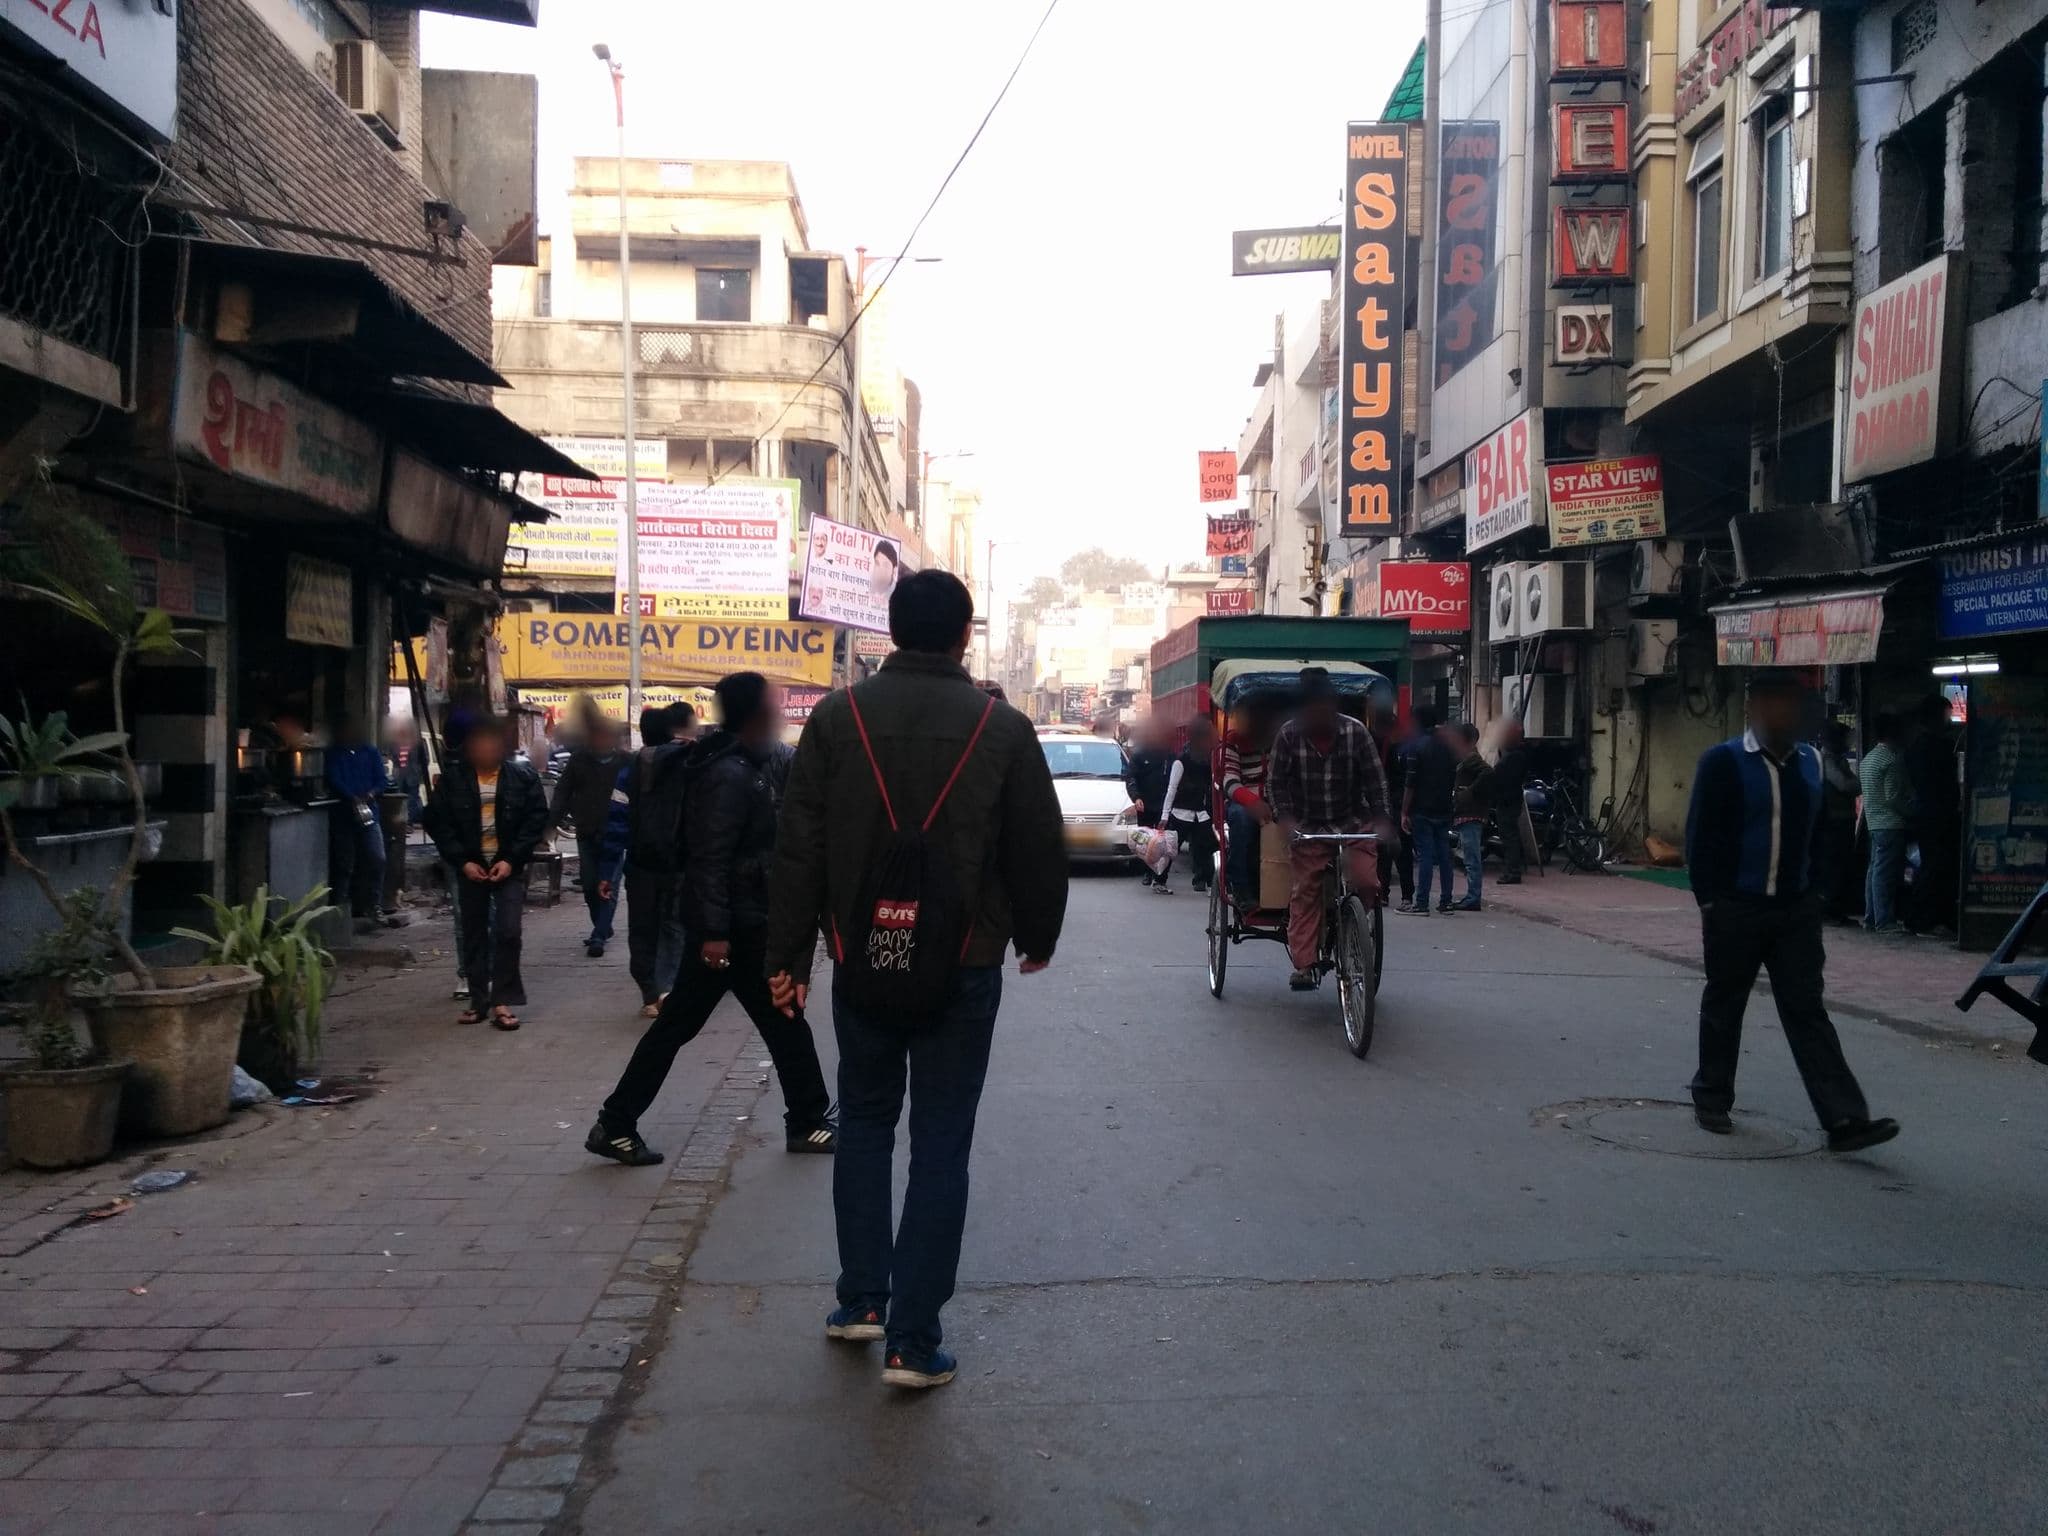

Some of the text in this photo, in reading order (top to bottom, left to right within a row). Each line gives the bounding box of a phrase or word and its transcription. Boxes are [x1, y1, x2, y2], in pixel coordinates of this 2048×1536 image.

[1349, 135, 1404, 160] HOTEL
[1245, 233, 1340, 265] SUBWA
[1562, 313, 1612, 354] DX
[1853, 271, 1942, 401] SWAGAT
[1347, 171, 1397, 524] Satyam
[1207, 459, 1225, 468] For
[1465, 449, 1479, 489] MY
[1477, 418, 1529, 517] BAR
[1584, 461, 1624, 473] HOTEL
[1201, 472, 1234, 484] Long
[1552, 465, 1658, 493] STAR VIEW
[1203, 487, 1233, 499] Stay
[1554, 491, 1660, 512] INDIA TRIP MAKERS
[597, 502, 615, 511] 2014
[1561, 503, 1654, 518] COMPLETE TRAVEL PLANNER
[741, 522, 775, 537] दिवस
[1475, 499, 1529, 541] RESTAURANT
[829, 525, 875, 553] Total TV
[1943, 545, 2022, 580] TOURIST
[1942, 568, 2044, 597] RESERVATION FOR FLIGHT
[1383, 589, 1467, 611] MYbar
[1953, 595, 1990, 614] SPECIAL
[1990, 589, 2034, 608] PACKAGE
[530, 620, 825, 655] BOMBAY DYEING
[525, 693, 568, 704] Sweater
[642, 693, 683, 704] Sweater
[788, 694, 826, 707] JEAN
